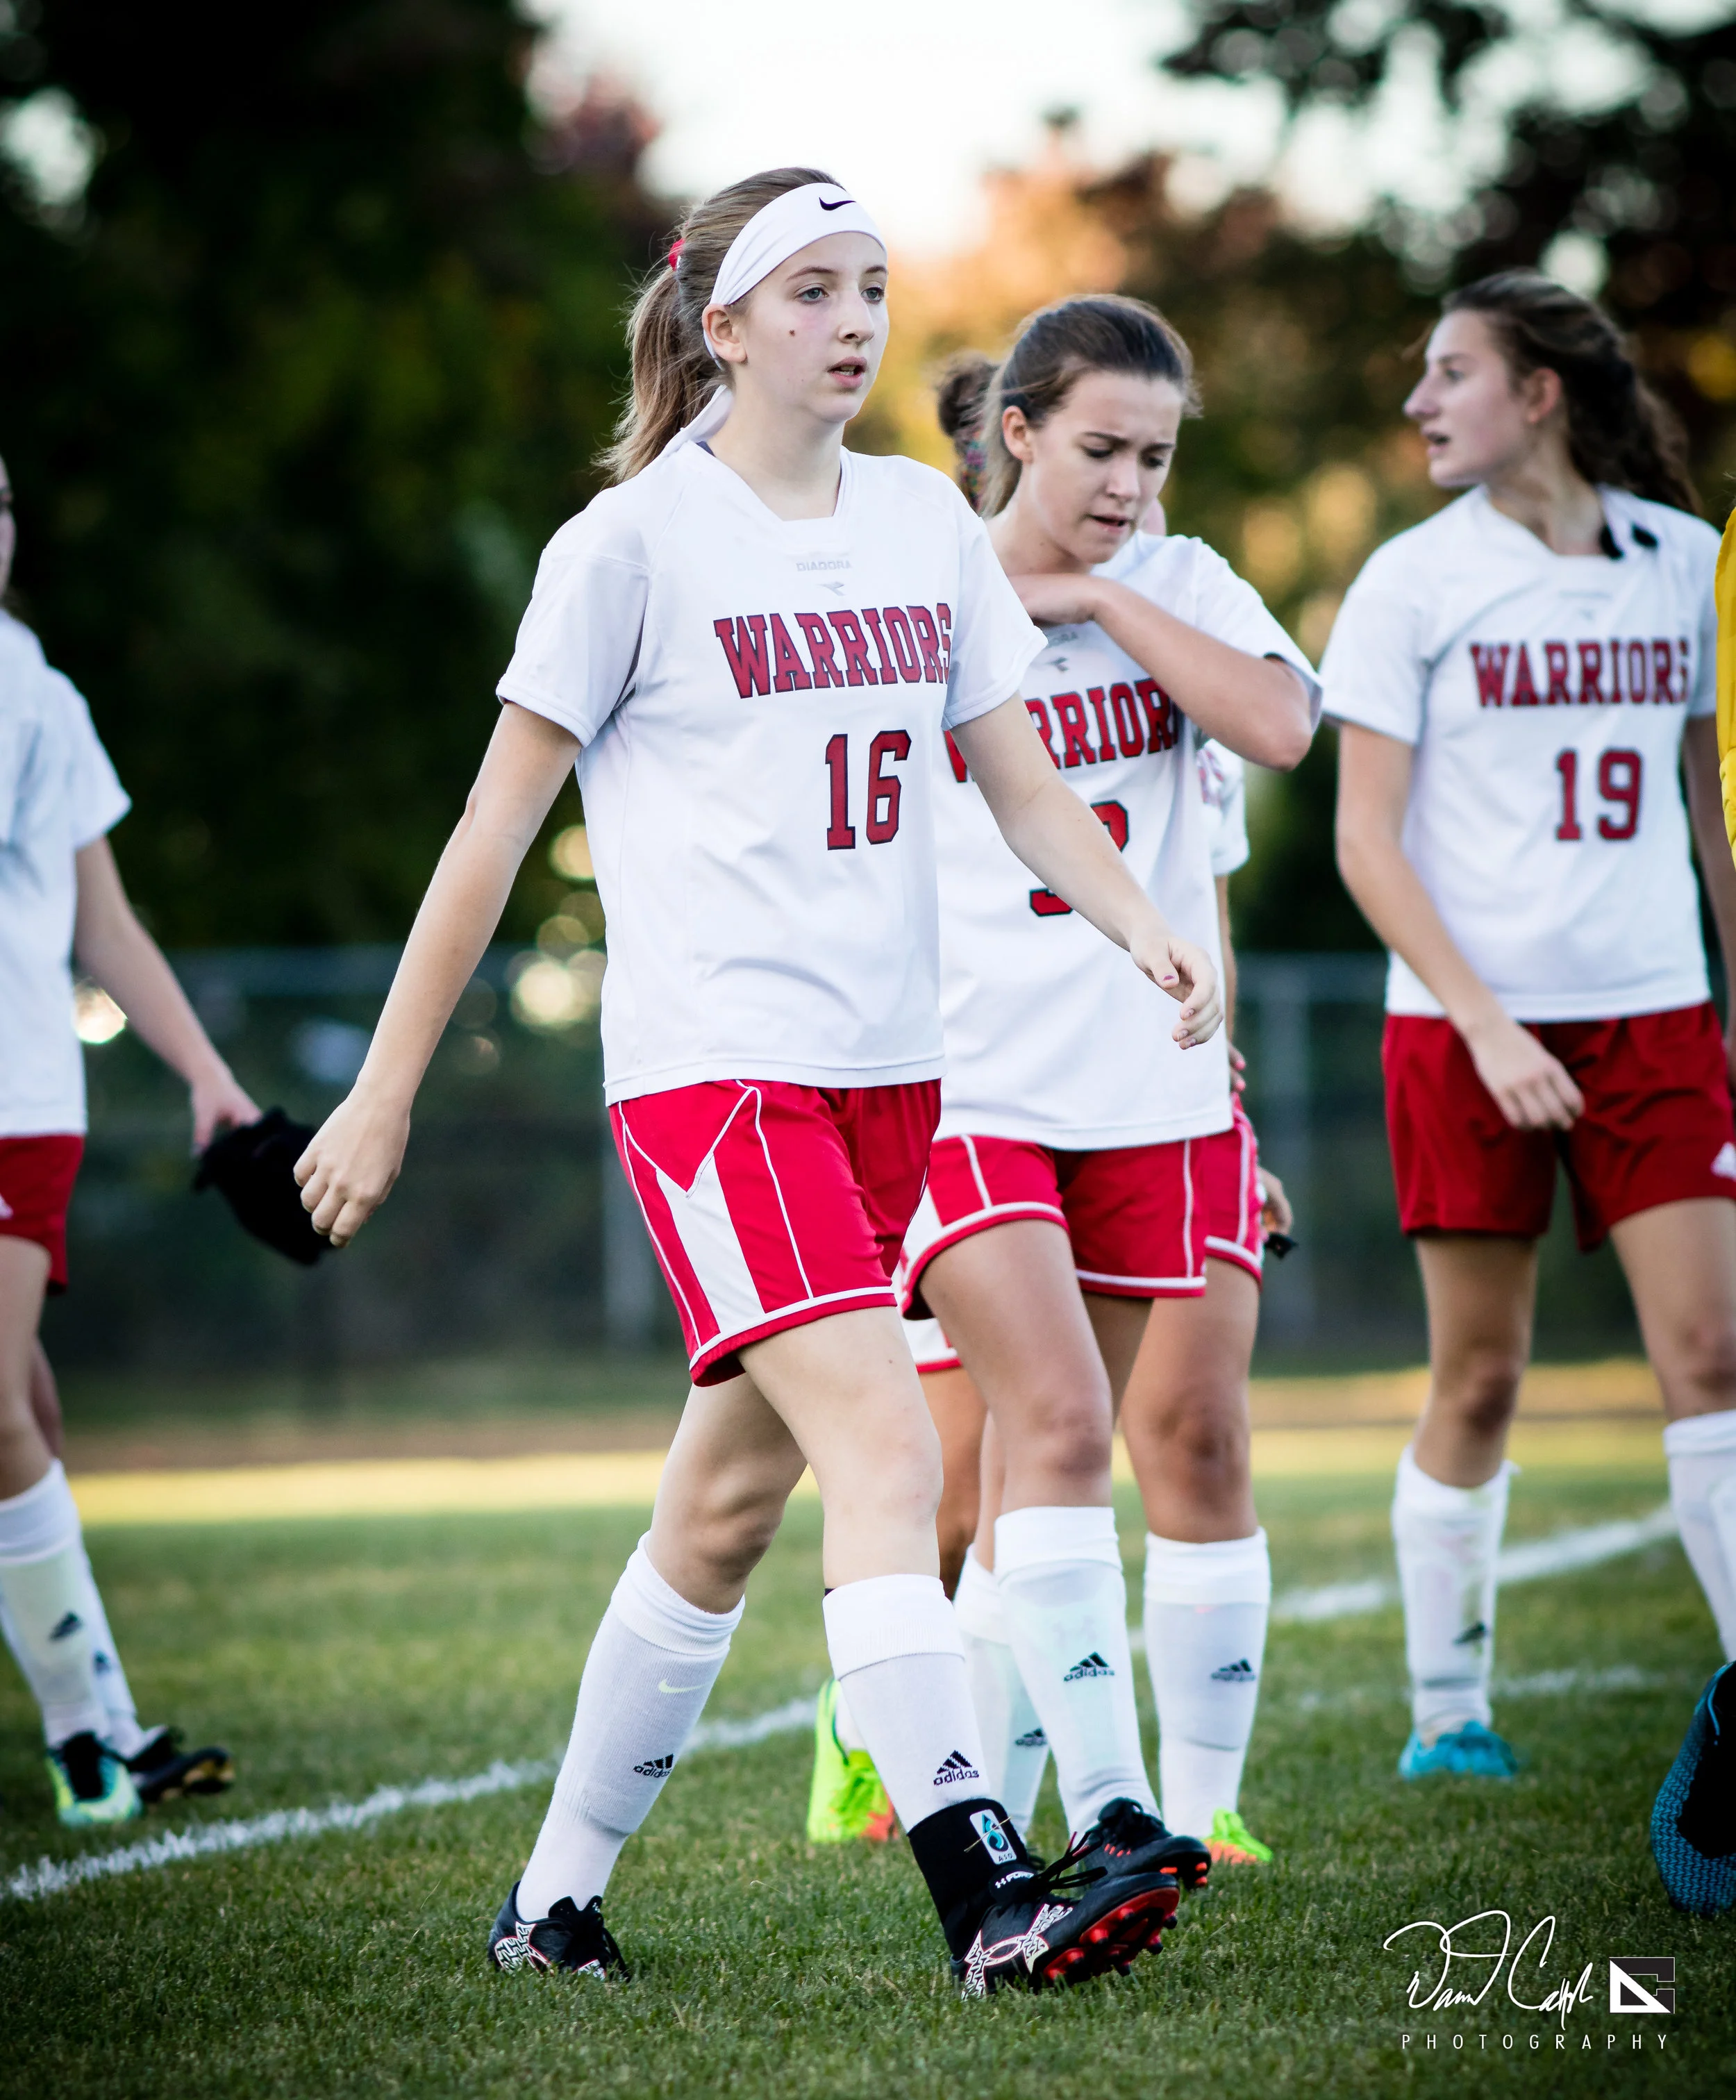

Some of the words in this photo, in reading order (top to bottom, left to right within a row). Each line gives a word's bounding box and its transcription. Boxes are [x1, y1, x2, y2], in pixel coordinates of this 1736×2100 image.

[796, 560, 853, 572] DIADORA
[713, 602, 951, 699] WARRIORS
[1469, 638, 1689, 707] WARRIORS
[944, 678, 1179, 783] RRIOR
[825, 729, 912, 851] 16
[1555, 749, 1643, 841] 19
[933, 1768, 979, 1785] adidas
